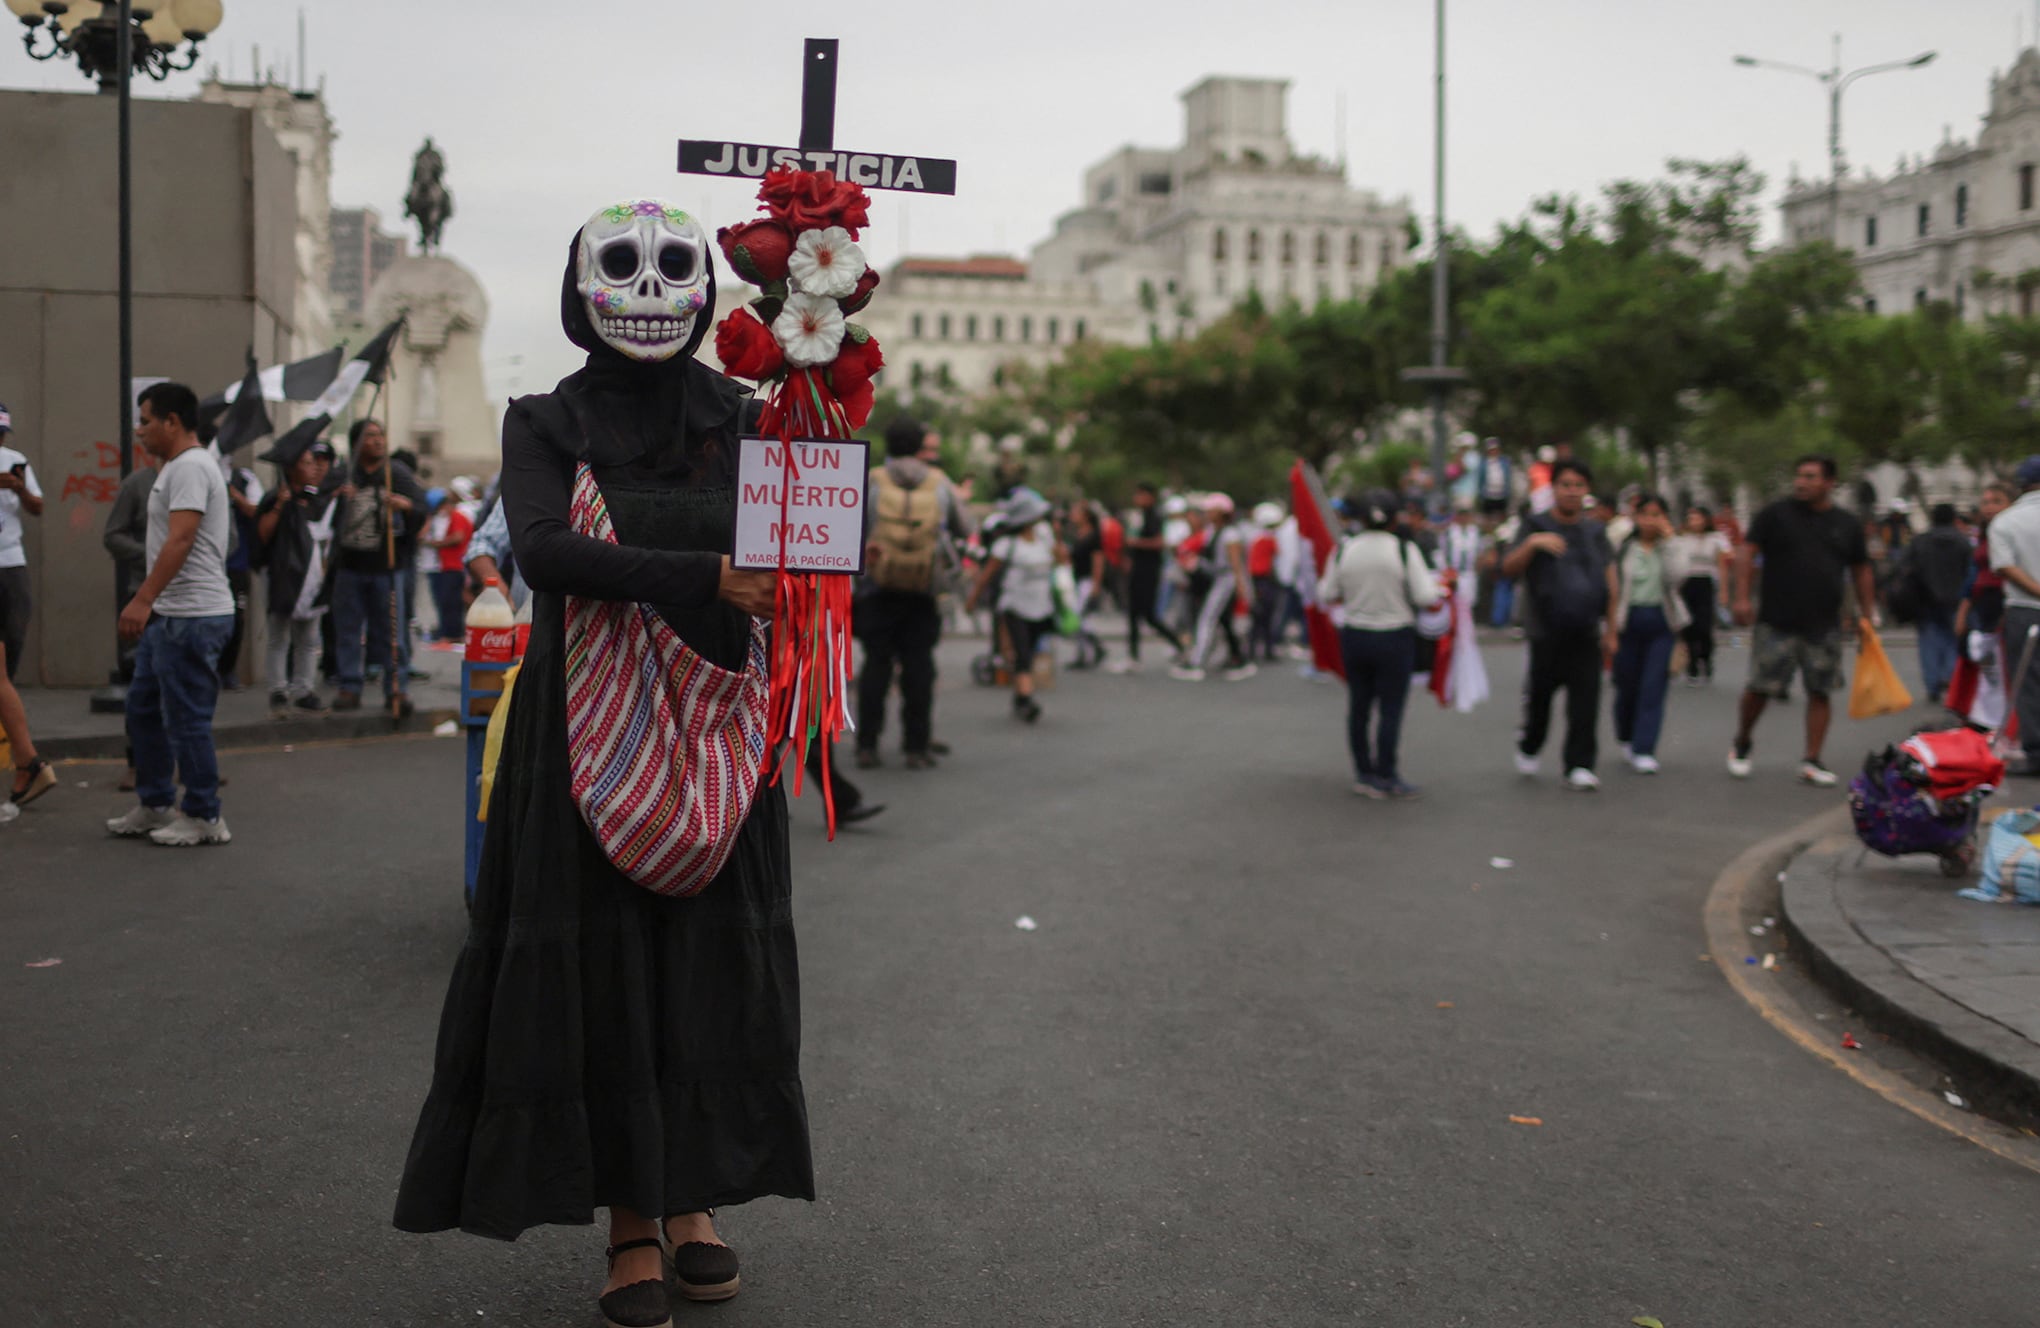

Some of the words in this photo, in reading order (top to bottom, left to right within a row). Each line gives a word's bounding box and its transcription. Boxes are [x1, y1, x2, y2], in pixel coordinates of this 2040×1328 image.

[704, 143, 924, 189] JUSTICIA
[764, 447, 790, 467] N
[802, 448, 840, 469] UN
[743, 483, 859, 508] MUERTO
[769, 522, 830, 545] MAS
[801, 554, 851, 567] PACÍFICA
